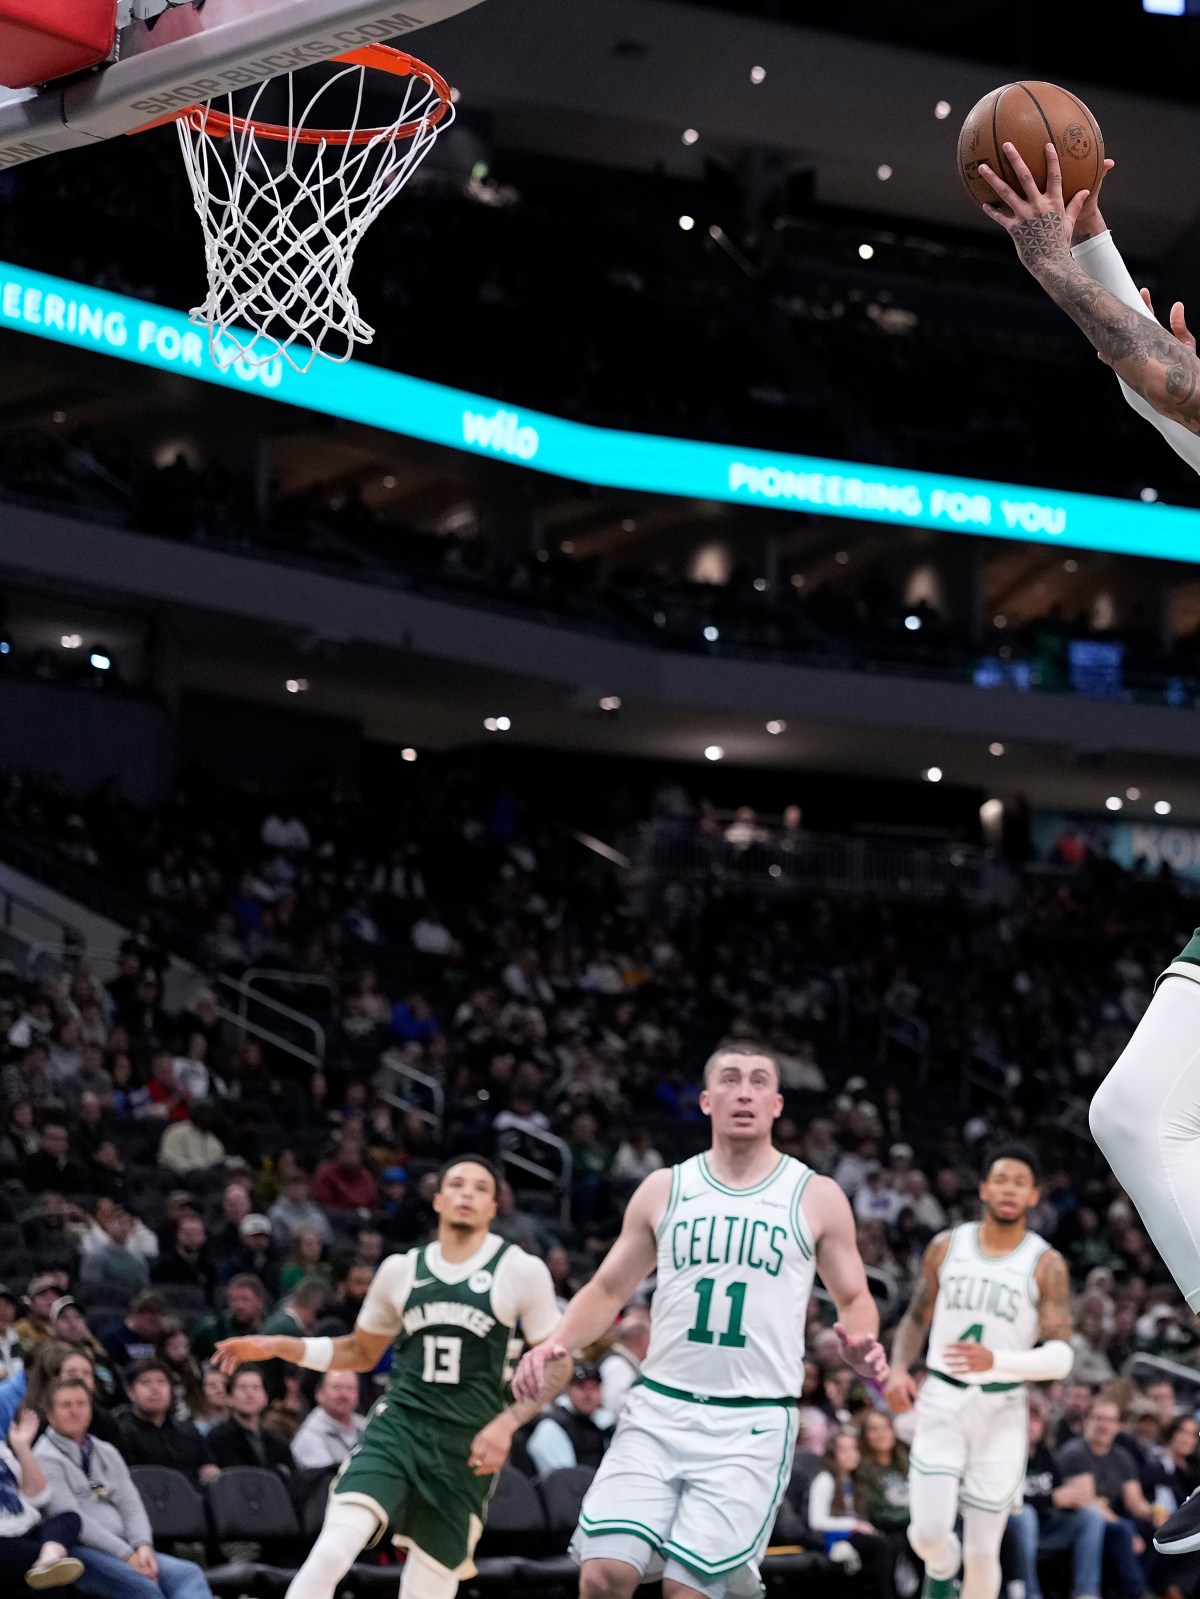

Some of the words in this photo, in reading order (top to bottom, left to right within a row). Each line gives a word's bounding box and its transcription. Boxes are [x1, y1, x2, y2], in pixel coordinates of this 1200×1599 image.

[129, 12, 425, 116] SHOP.BUCKS.COM
[138, 320, 203, 368] FOR
[213, 338, 284, 388] YOU
[728, 461, 923, 517] PIONEERING
[930, 488, 992, 526] FOR
[1000, 498, 1067, 535] YOU
[671, 1215, 788, 1277] CELTICS
[687, 1277, 747, 1348] 11
[945, 1275, 1021, 1324] CELTICS
[422, 1334, 463, 1385] 13
